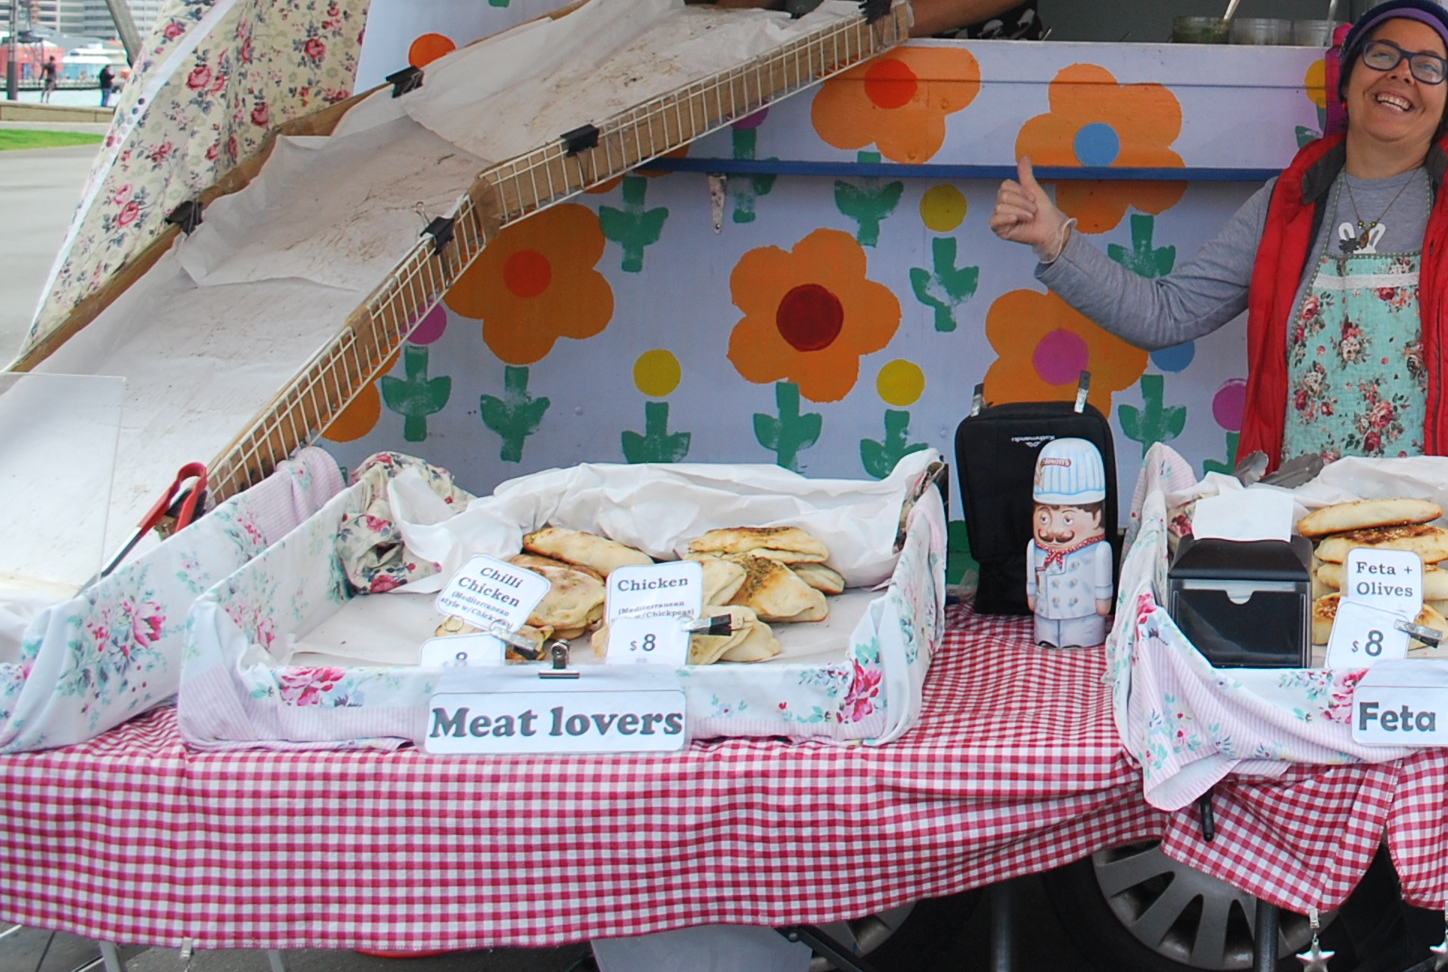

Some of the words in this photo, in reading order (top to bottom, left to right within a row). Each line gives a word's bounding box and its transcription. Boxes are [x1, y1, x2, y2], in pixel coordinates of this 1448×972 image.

[480, 567, 523, 588] Chilli
[1356, 561, 1396, 575] Feta
[1404, 566, 1412, 574] +
[458, 576, 520, 607] Chicken
[617, 578, 688, 592] Chicken
[1356, 582, 1413, 597] Olives
[429, 707, 538, 738] Meat
[548, 706, 683, 736] lovers
[1359, 701, 1436, 732] Feta
